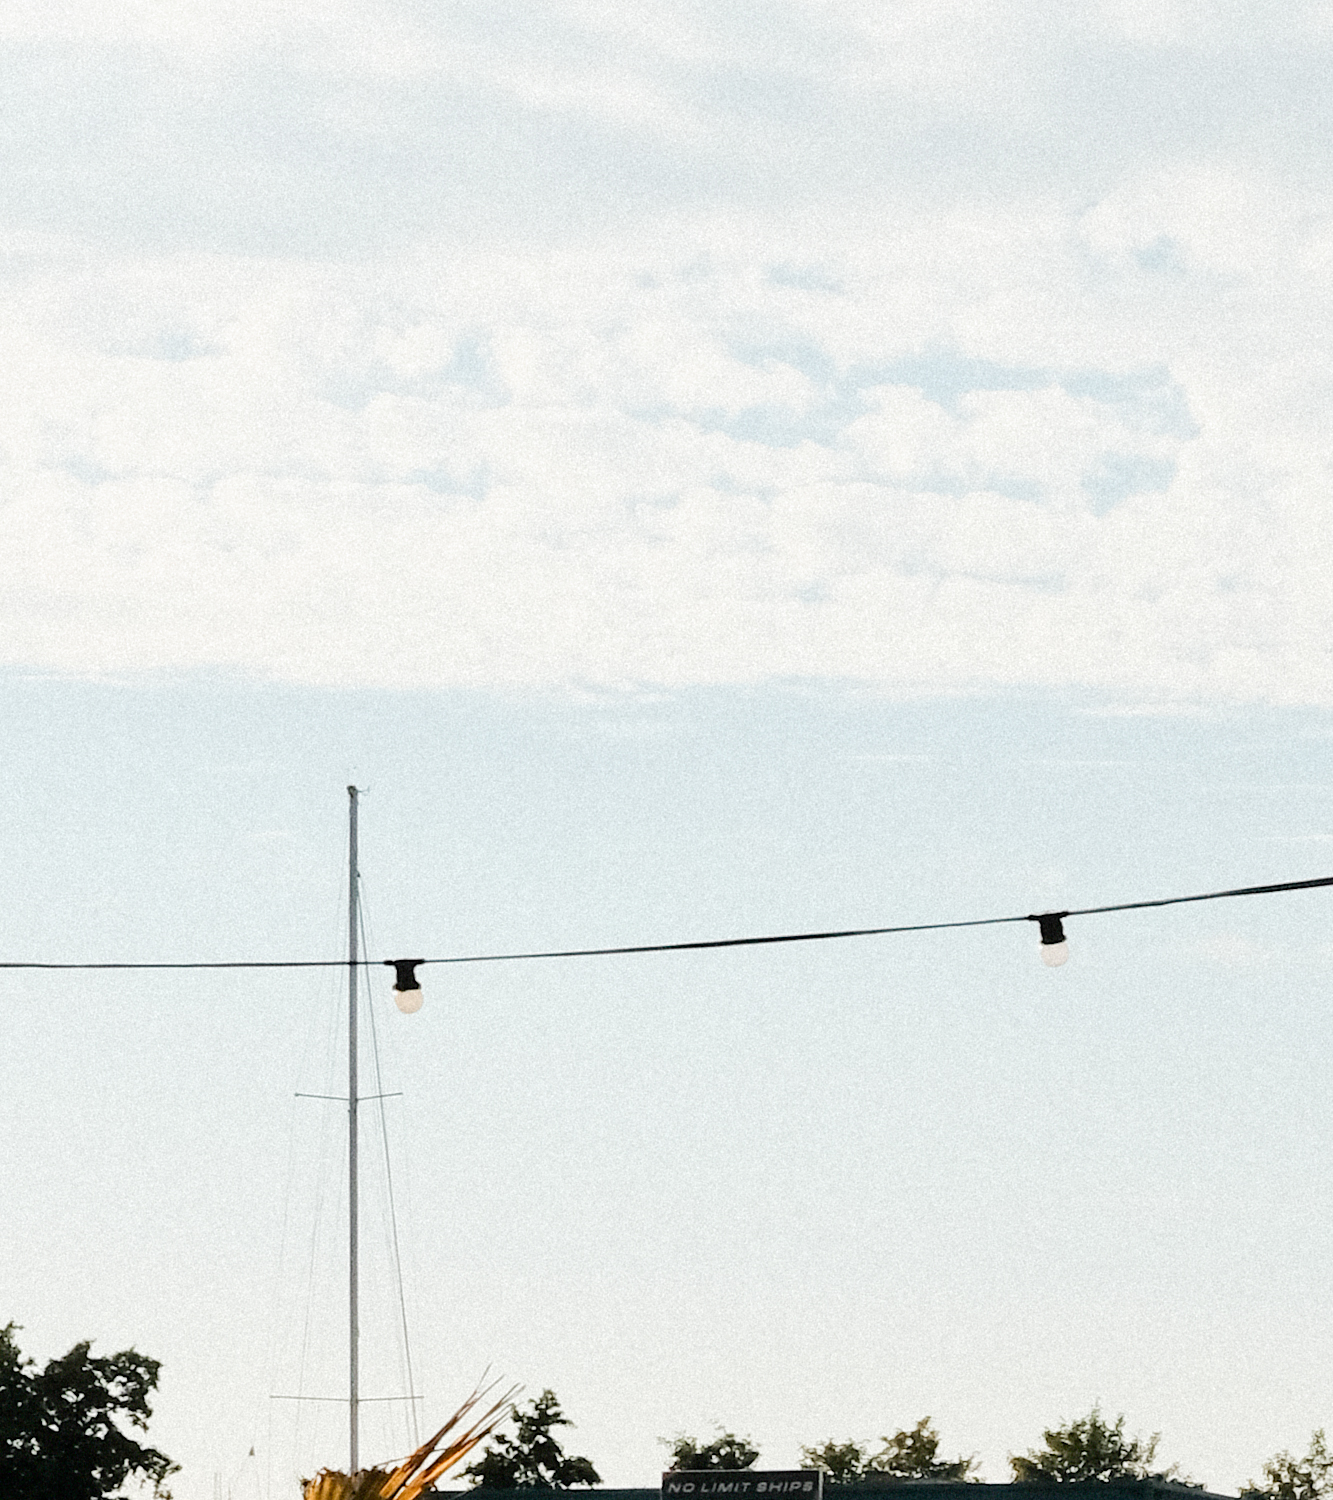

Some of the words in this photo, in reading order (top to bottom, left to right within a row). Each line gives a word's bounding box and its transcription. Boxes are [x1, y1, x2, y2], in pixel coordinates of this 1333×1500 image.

[667, 1482, 696, 1493] NO
[700, 1482, 752, 1493] LIMIT
[756, 1481, 814, 1493] SHIPS
